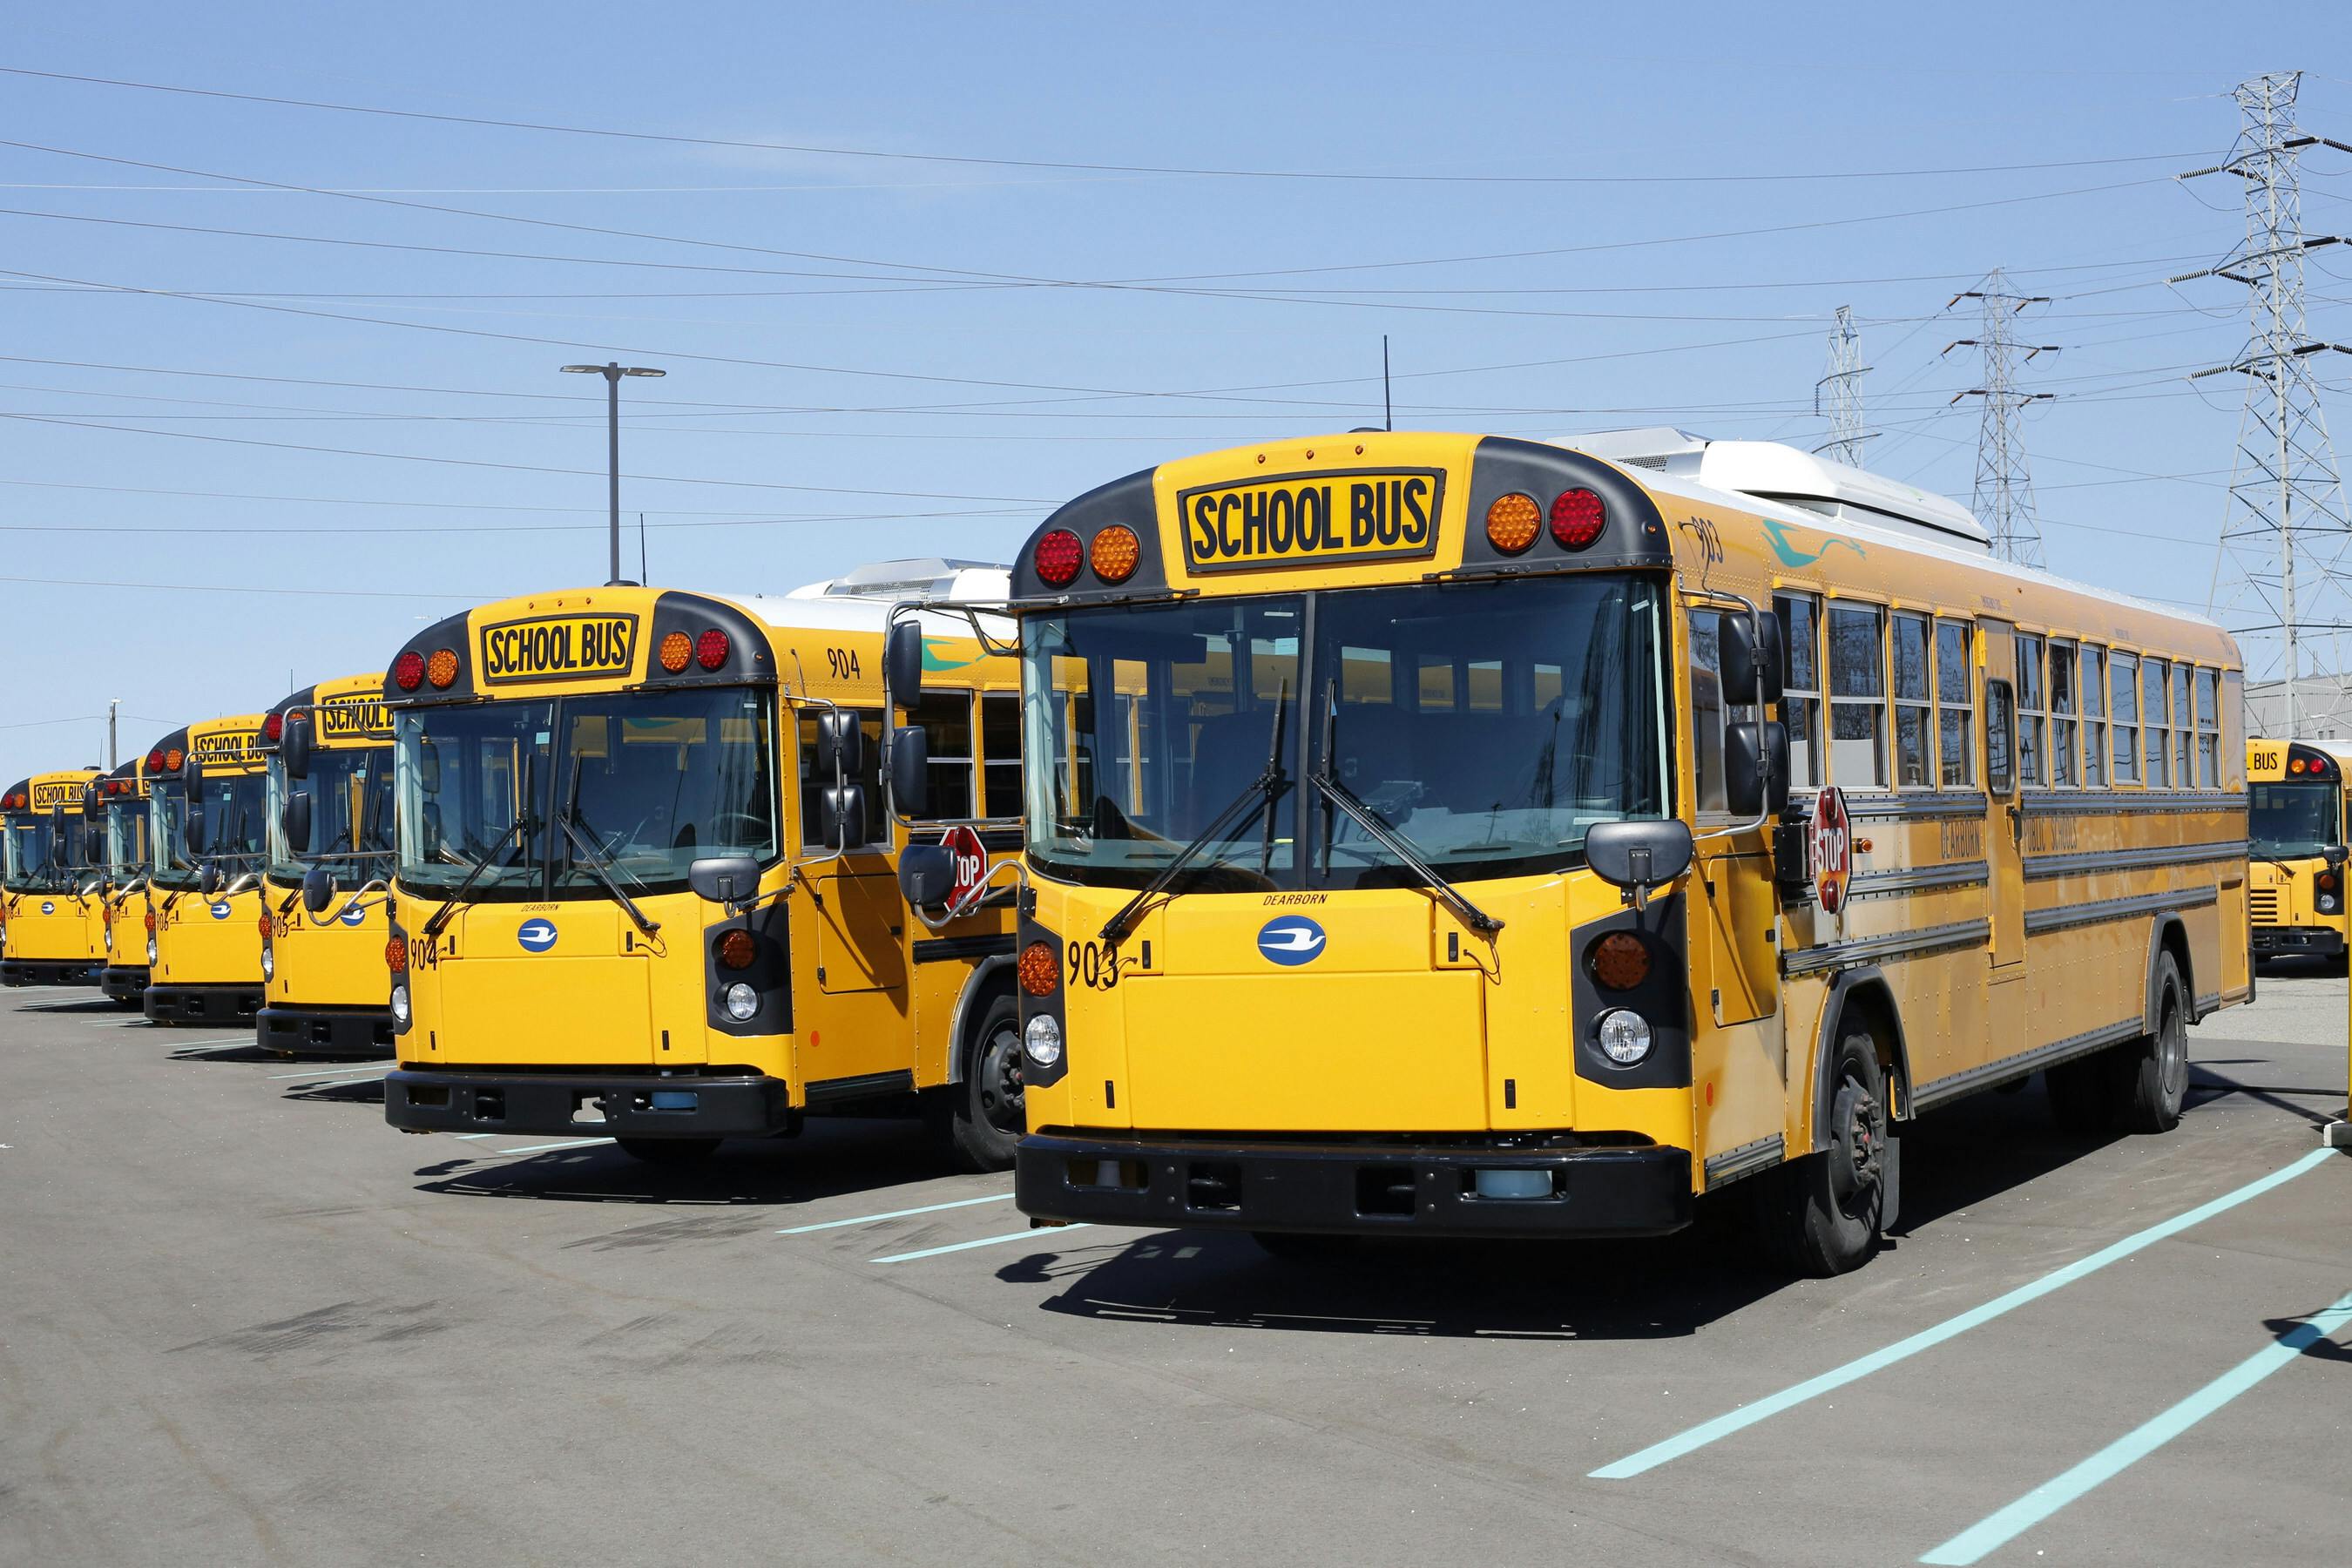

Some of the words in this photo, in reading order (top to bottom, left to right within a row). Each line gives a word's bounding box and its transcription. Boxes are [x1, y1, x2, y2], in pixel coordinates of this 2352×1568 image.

[1193, 486, 1344, 559] SCHOOL
[1350, 477, 1428, 547] BUS
[1691, 516, 1724, 564] 903
[489, 621, 578, 674] SCHOOL
[581, 620, 627, 666] BUS
[827, 647, 860, 679] 904
[327, 698, 384, 730] SCHOOL
[199, 736, 246, 763] SCHOOL
[2254, 752, 2278, 770] BUS
[37, 785, 66, 804] SCHOOL
[1816, 827, 1844, 874] STOP
[1263, 894, 1328, 906] DEARBORN
[411, 938, 437, 971] 904
[1068, 941, 1119, 989] 903
